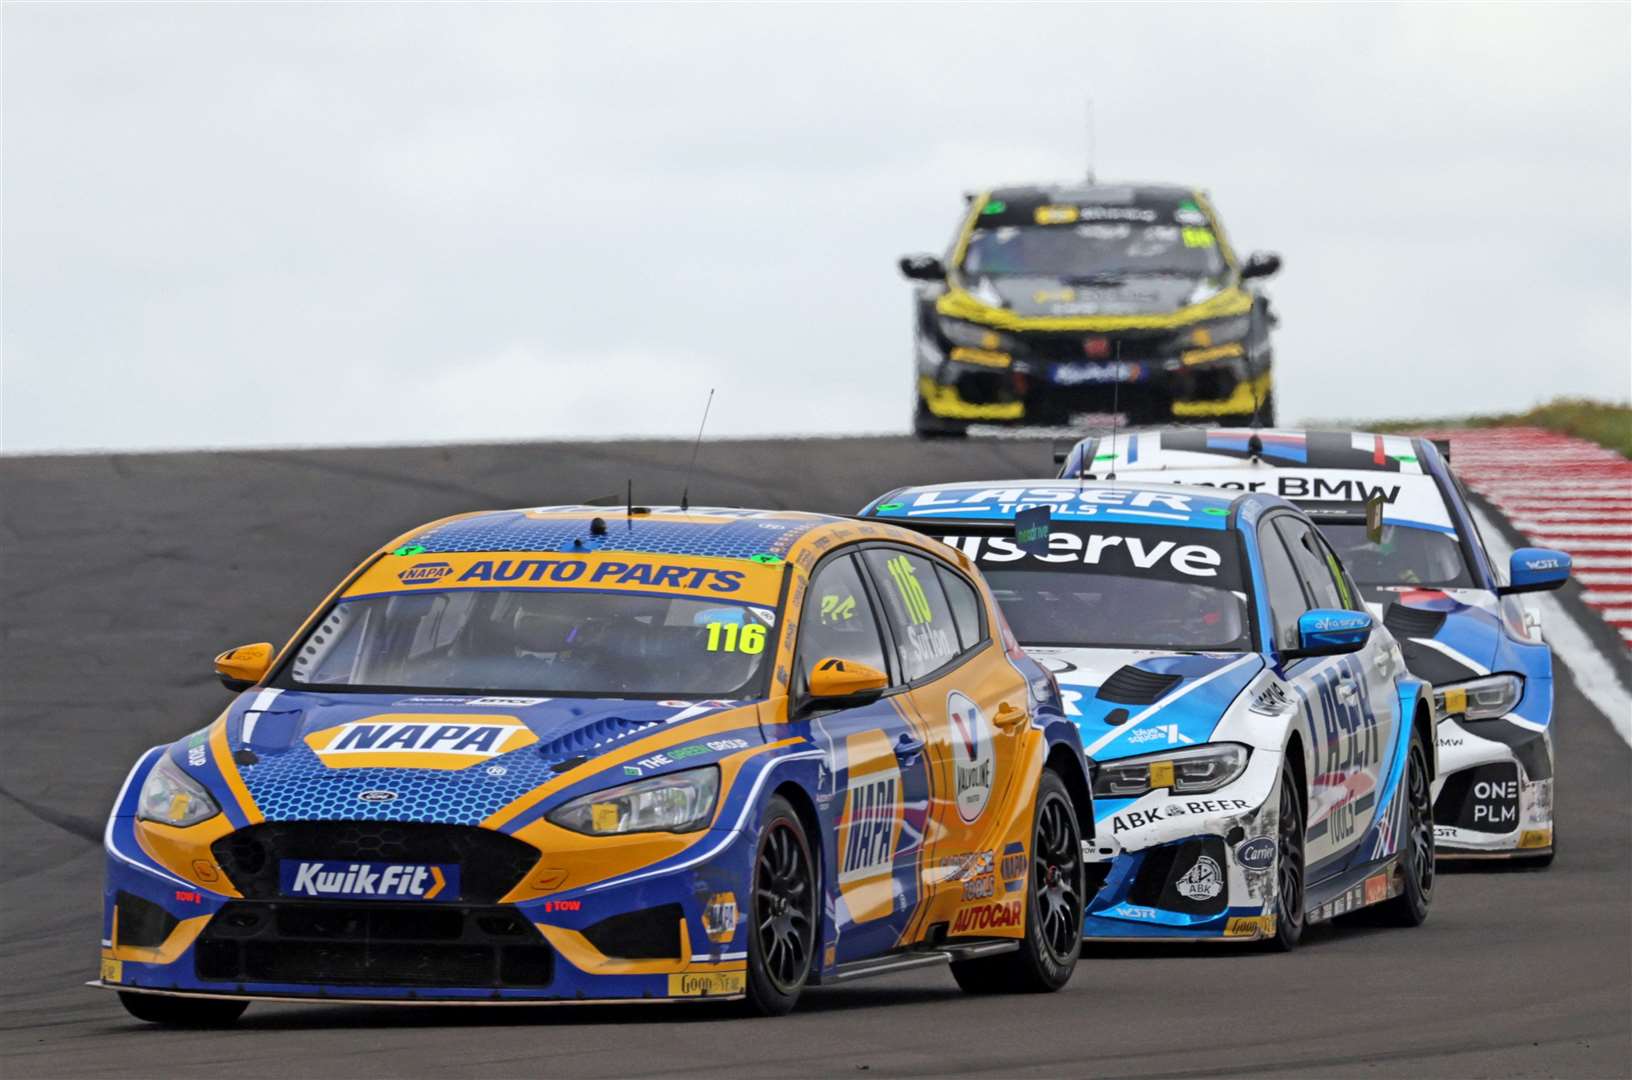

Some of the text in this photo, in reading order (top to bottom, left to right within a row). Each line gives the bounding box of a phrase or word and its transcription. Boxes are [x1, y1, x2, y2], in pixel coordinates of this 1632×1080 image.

[912, 488, 1192, 512] LASER
[1278, 477, 1401, 504] BMW
[405, 560, 746, 593] NAPA AUTO PARTS
[706, 622, 767, 655] 116
[338, 724, 503, 753] NAPA
[1436, 739, 1463, 747] MW
[637, 754, 674, 769] THE
[706, 738, 750, 751] GROUP
[1474, 782, 1517, 799] ONE
[844, 778, 895, 873] NAPA
[1112, 799, 1252, 834] ABK BEER
[1474, 805, 1516, 822] PLM
[1244, 846, 1274, 861] Carrier
[1189, 884, 1211, 894] ABK
[555, 901, 581, 911] TOW
[951, 900, 1022, 933] AUTOCAR
